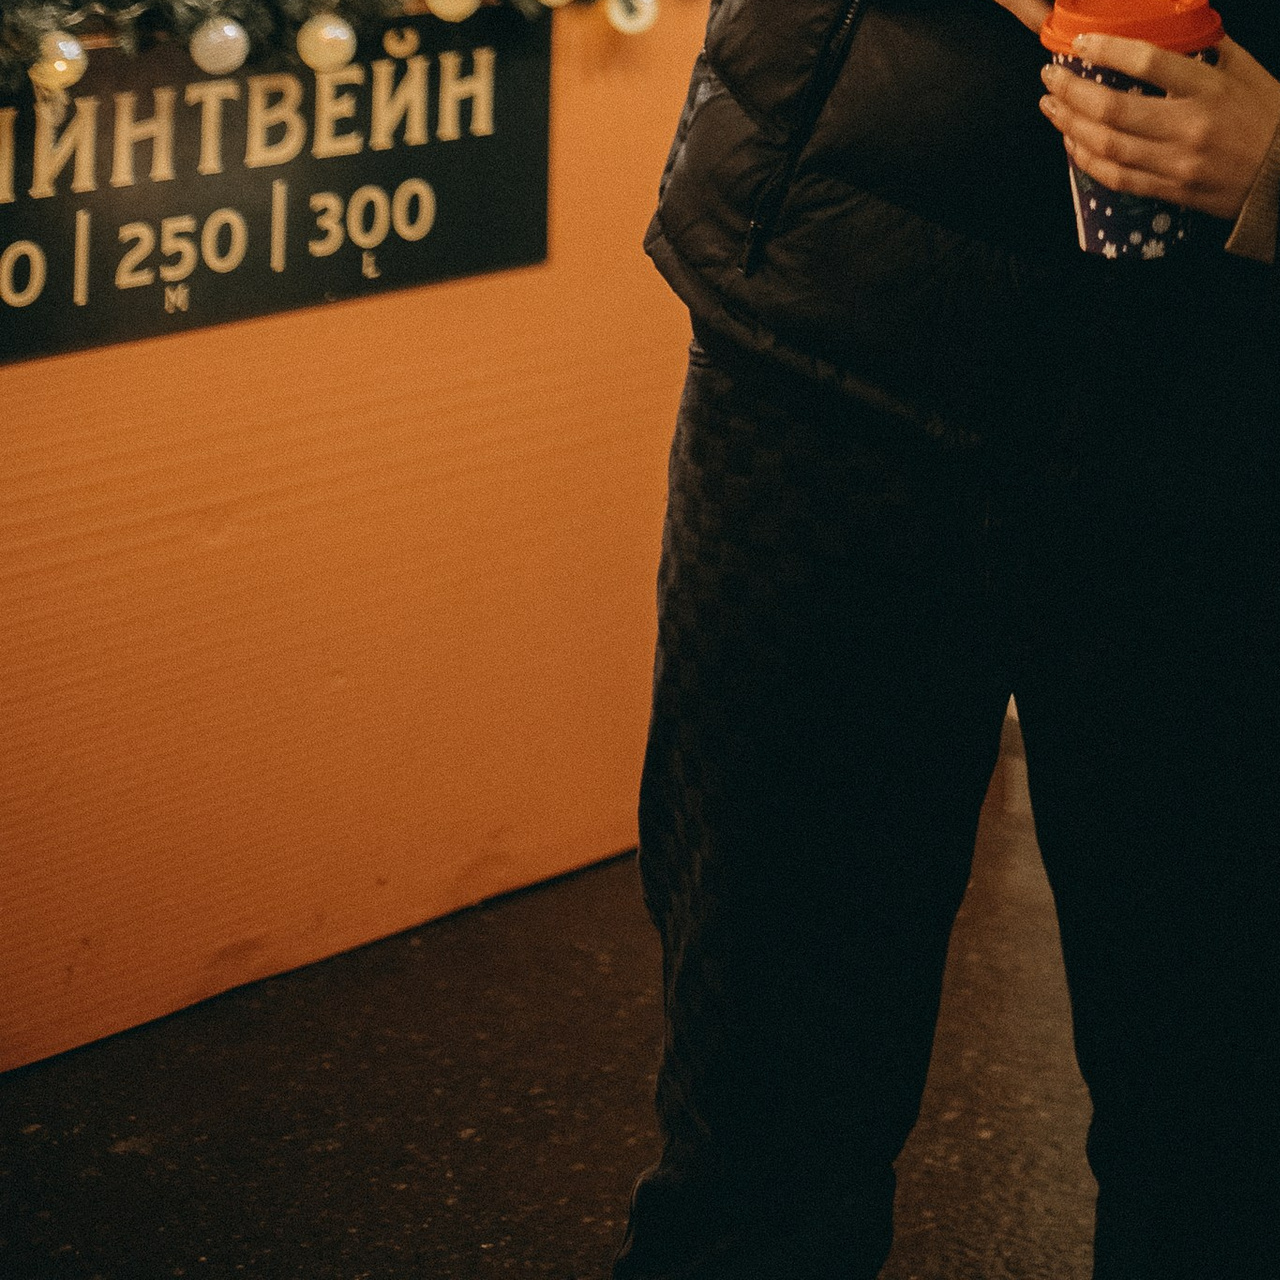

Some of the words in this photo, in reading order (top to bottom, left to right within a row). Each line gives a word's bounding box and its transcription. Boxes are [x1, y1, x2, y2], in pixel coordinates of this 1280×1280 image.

[0, 26, 496, 204] ИНТВЕЙН
[115, 207, 248, 289] 250
[308, 177, 437, 258] 300
